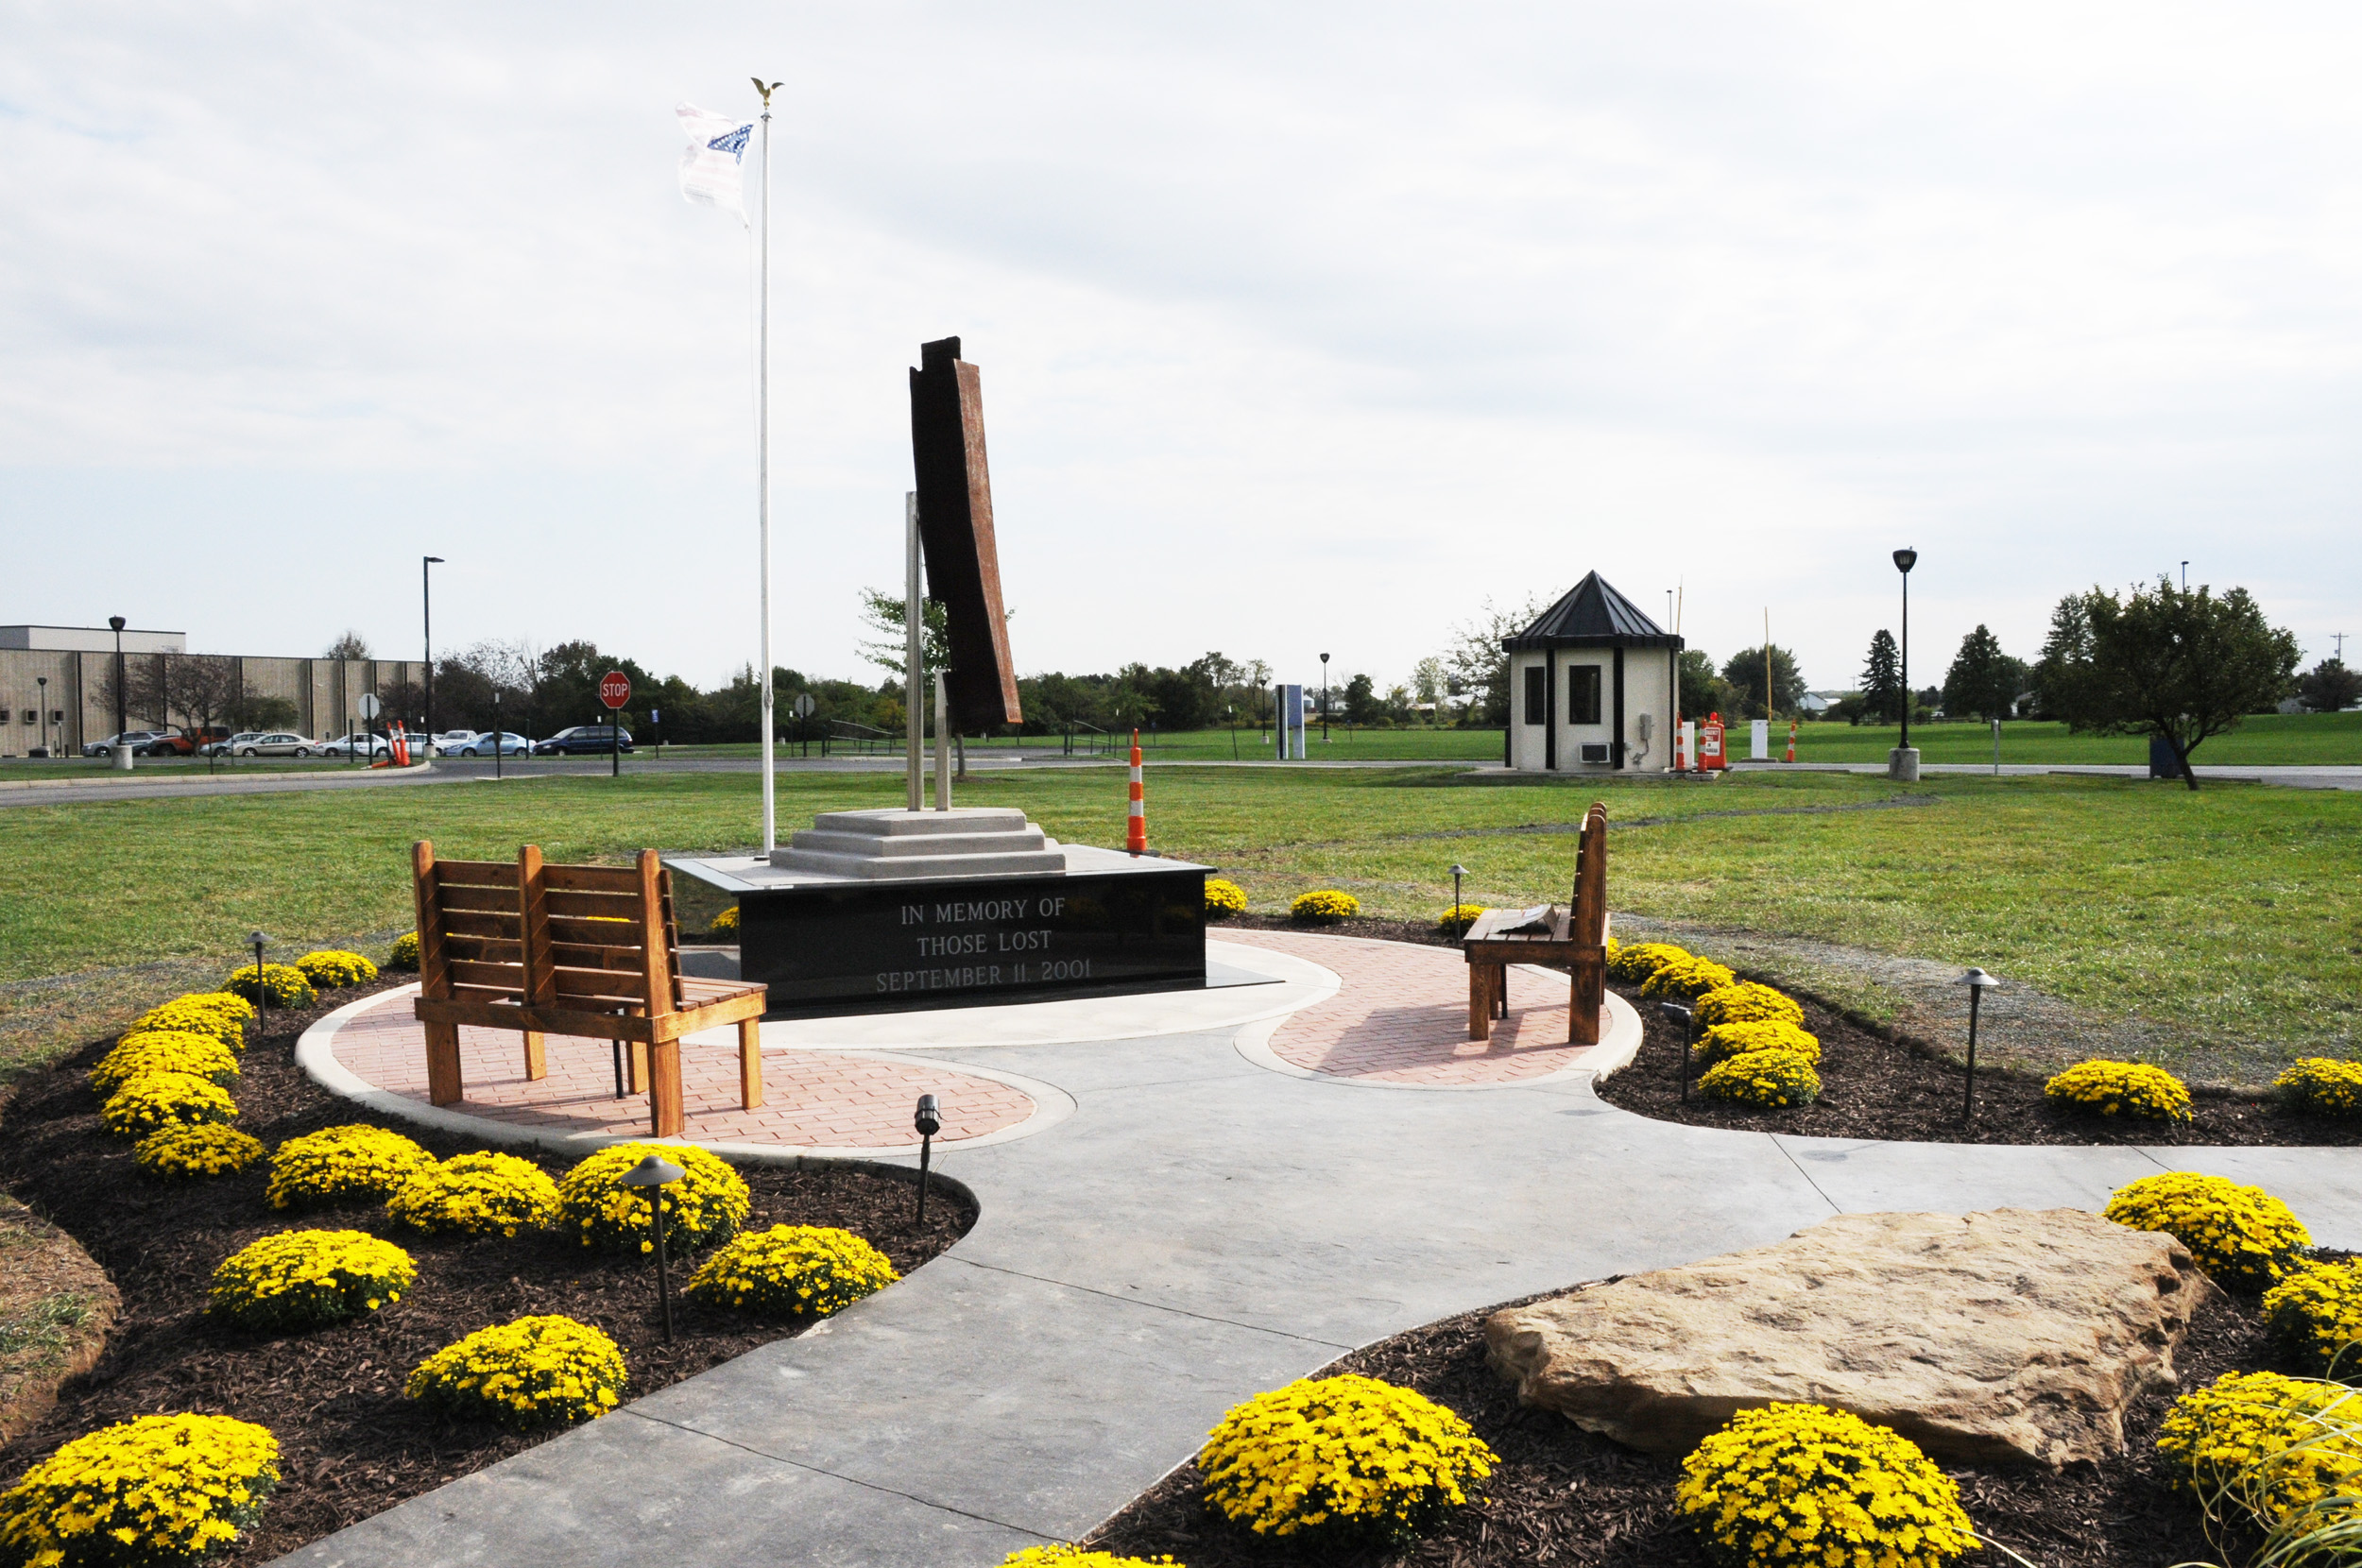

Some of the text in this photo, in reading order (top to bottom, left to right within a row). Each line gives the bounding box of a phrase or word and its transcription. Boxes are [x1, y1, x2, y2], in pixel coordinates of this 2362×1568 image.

[603, 683, 628, 697] STOP
[901, 897, 1065, 925] IN MEMORY OF
[916, 929, 1053, 957] THOSE LOST
[876, 965, 1002, 993] SEPTEMBER
[1041, 958, 1090, 980] 2001
